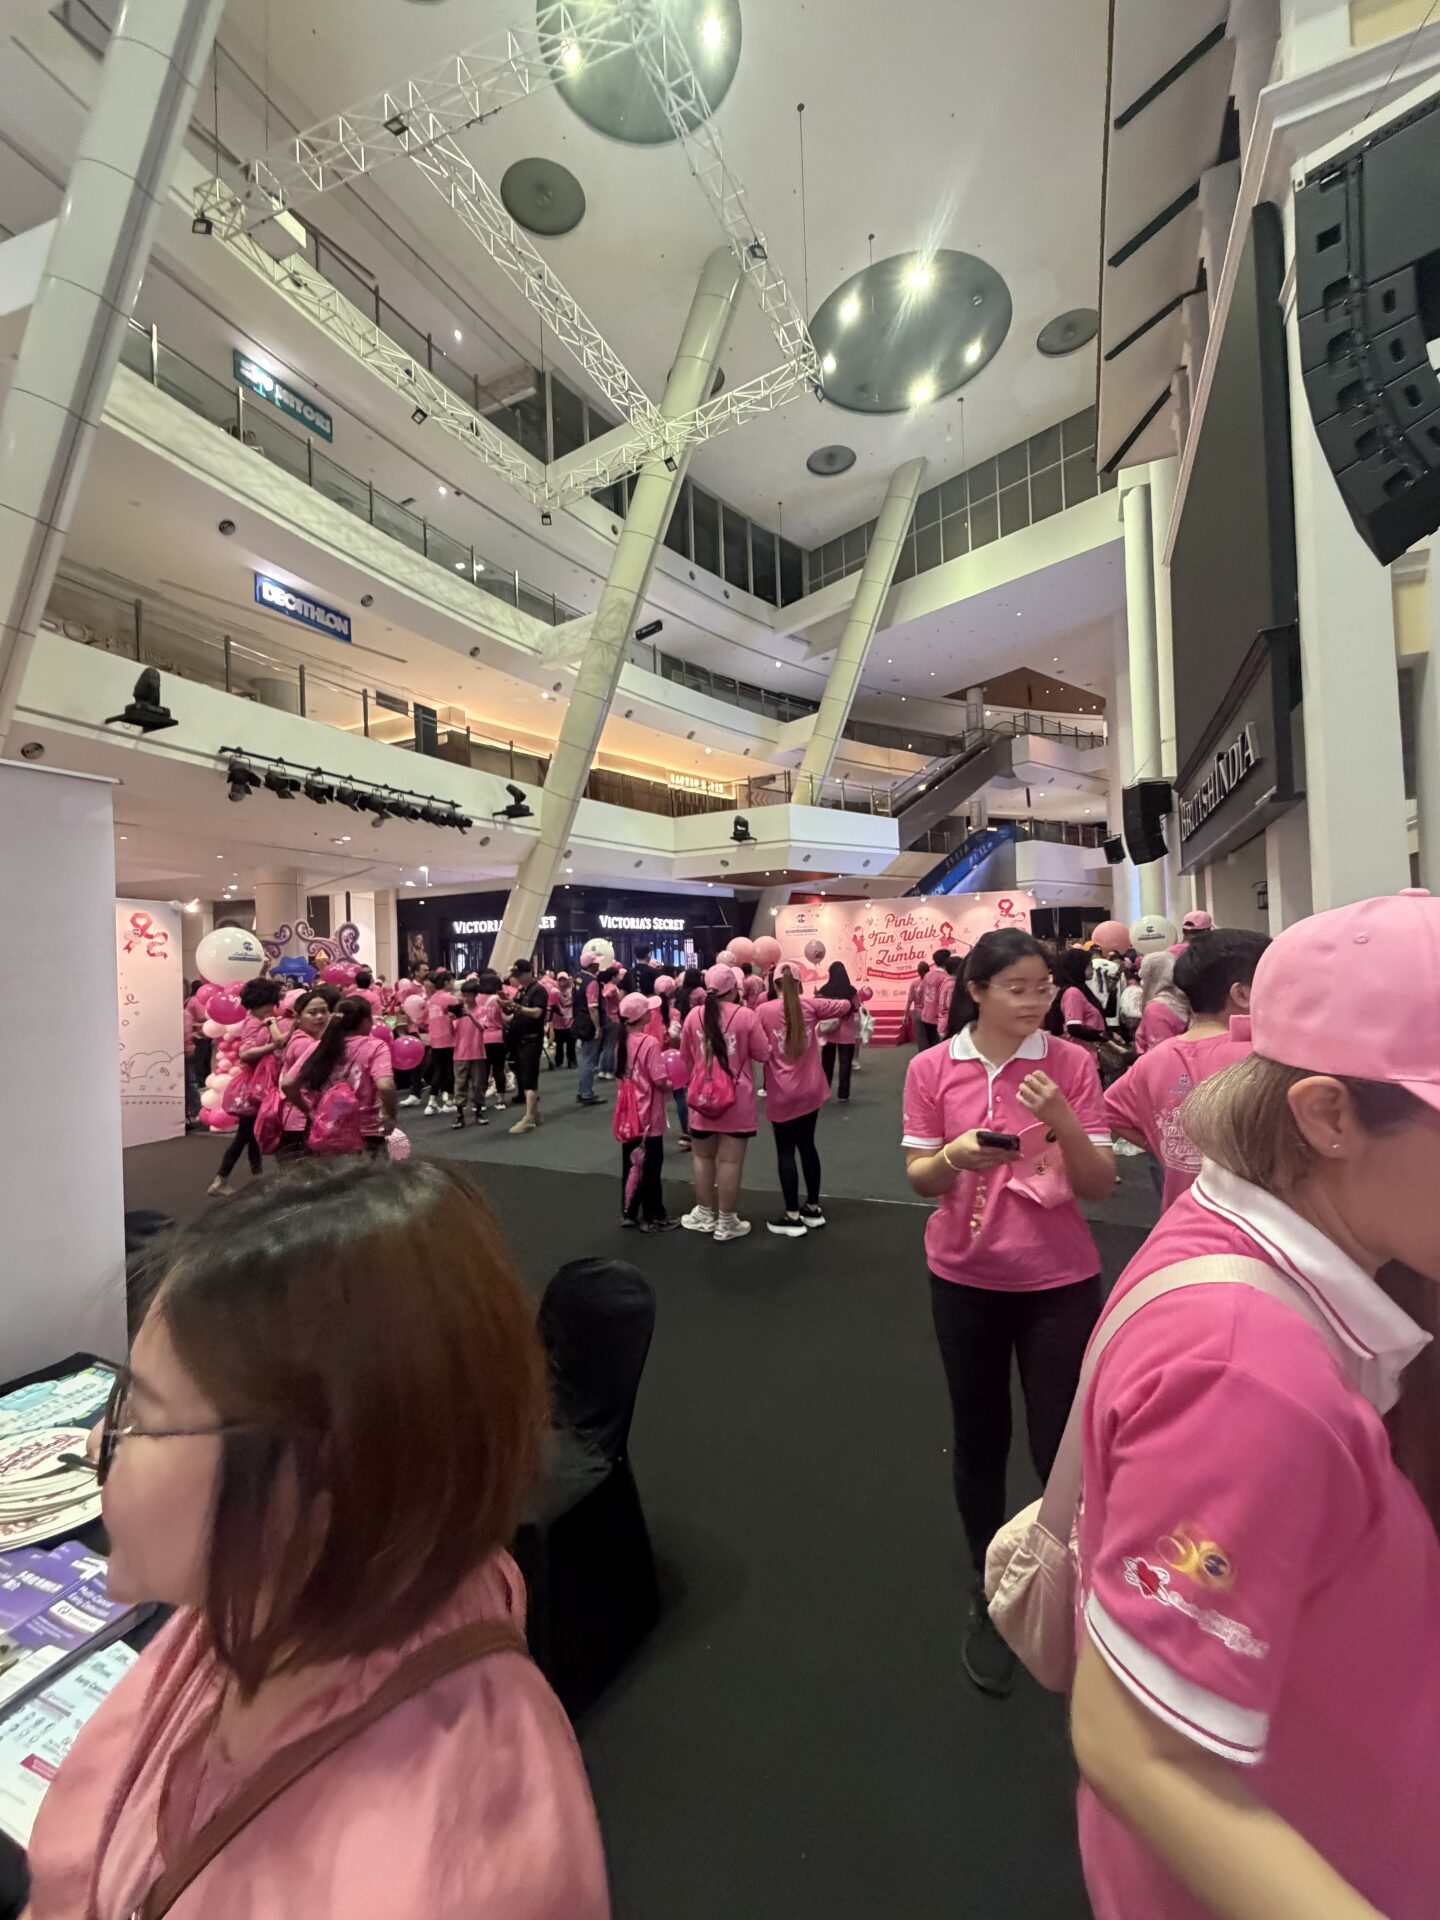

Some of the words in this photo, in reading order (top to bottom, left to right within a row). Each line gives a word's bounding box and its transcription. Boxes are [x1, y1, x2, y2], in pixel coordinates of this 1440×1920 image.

[262, 582, 349, 635] DECATHLON
[598, 914, 651, 930] VICTORIA'S
[652, 917, 685, 931] SECRET
[885, 913, 917, 929] Pink
[868, 930, 896, 947] Fun
[900, 924, 940, 942] Walk
[876, 945, 926, 966] Zumba
[896, 942, 902, 951] &
